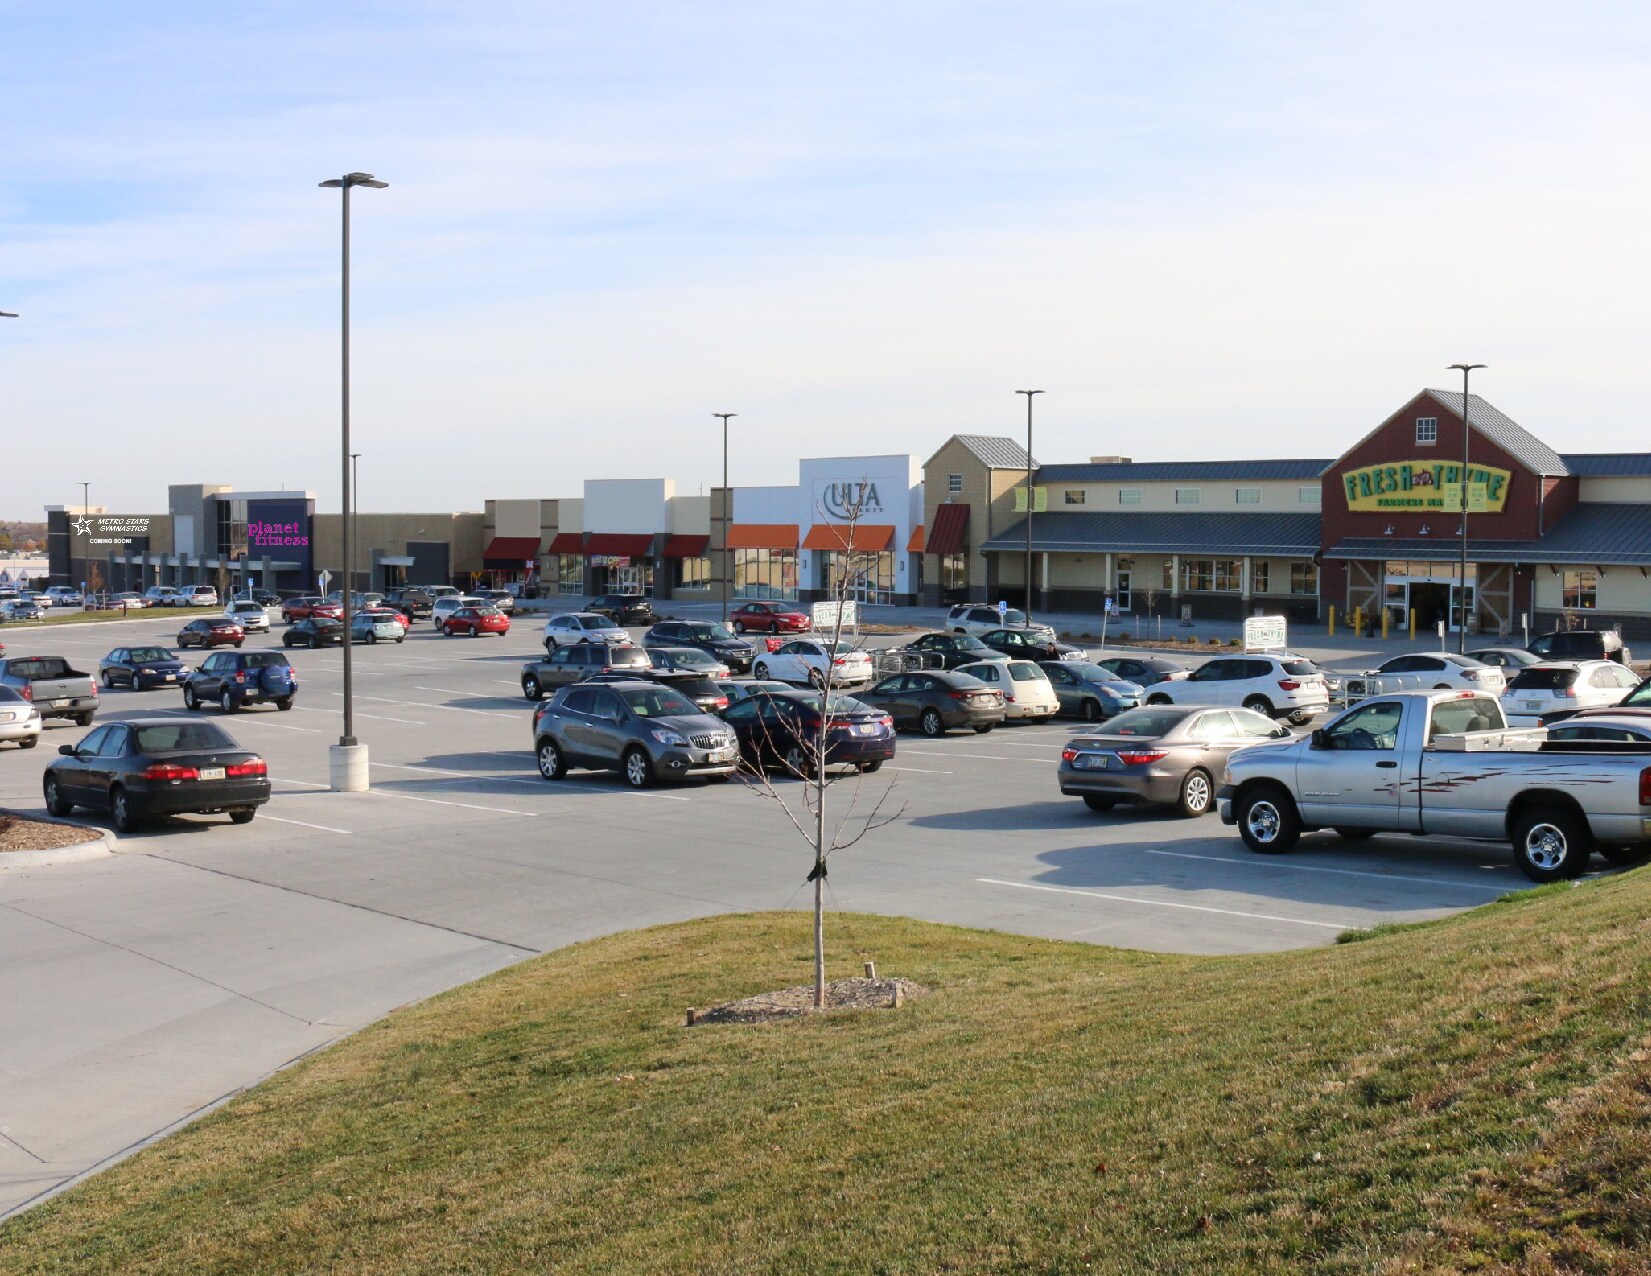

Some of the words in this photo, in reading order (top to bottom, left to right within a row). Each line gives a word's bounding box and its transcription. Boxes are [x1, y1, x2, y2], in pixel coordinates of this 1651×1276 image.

[1345, 465, 1412, 501] FRESH
[832, 483, 880, 506] ULTA
[247, 520, 299, 537] planet
[254, 534, 309, 546] fitness
